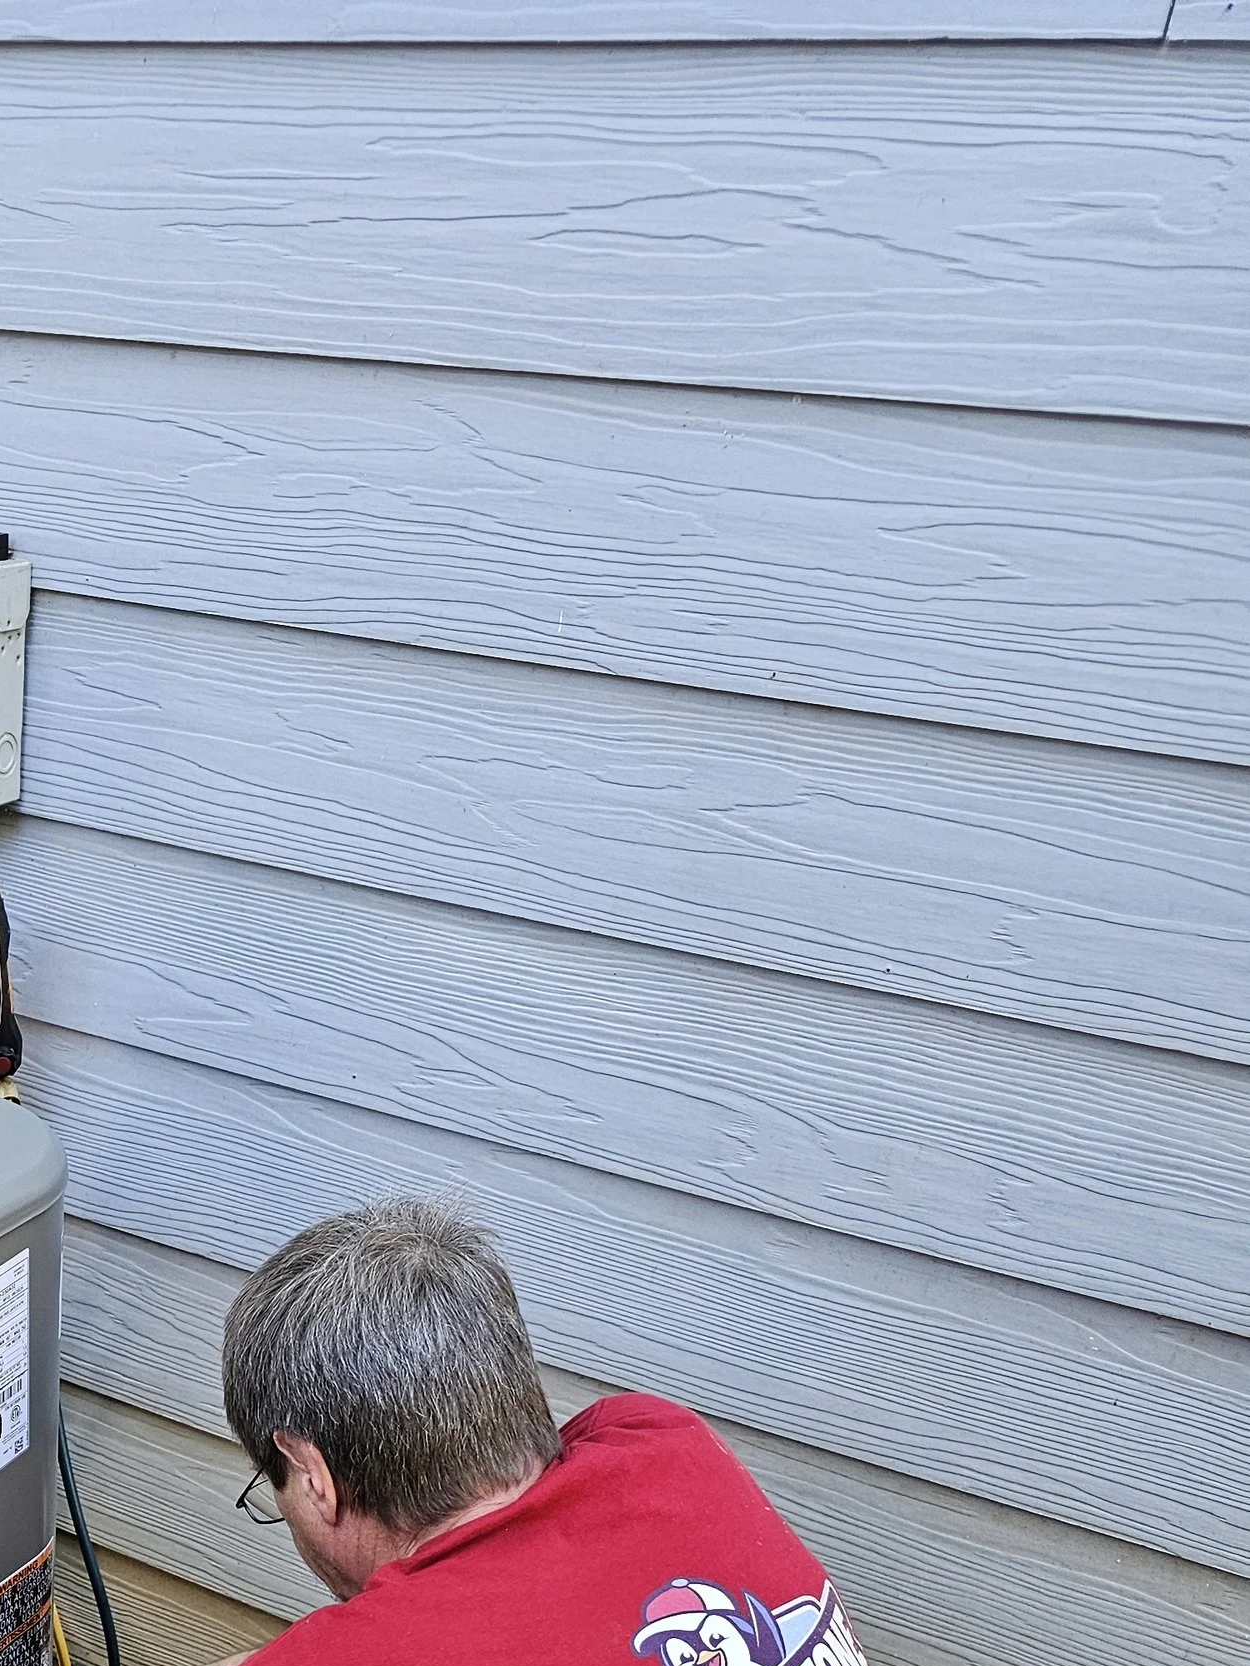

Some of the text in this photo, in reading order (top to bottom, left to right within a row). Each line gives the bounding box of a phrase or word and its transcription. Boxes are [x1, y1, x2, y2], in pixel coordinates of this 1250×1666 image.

[0, 1561, 38, 1594] WARNING
[24, 1589, 34, 1603] OR
[4, 1597, 12, 1610] IN
[36, 1627, 44, 1642] ET
